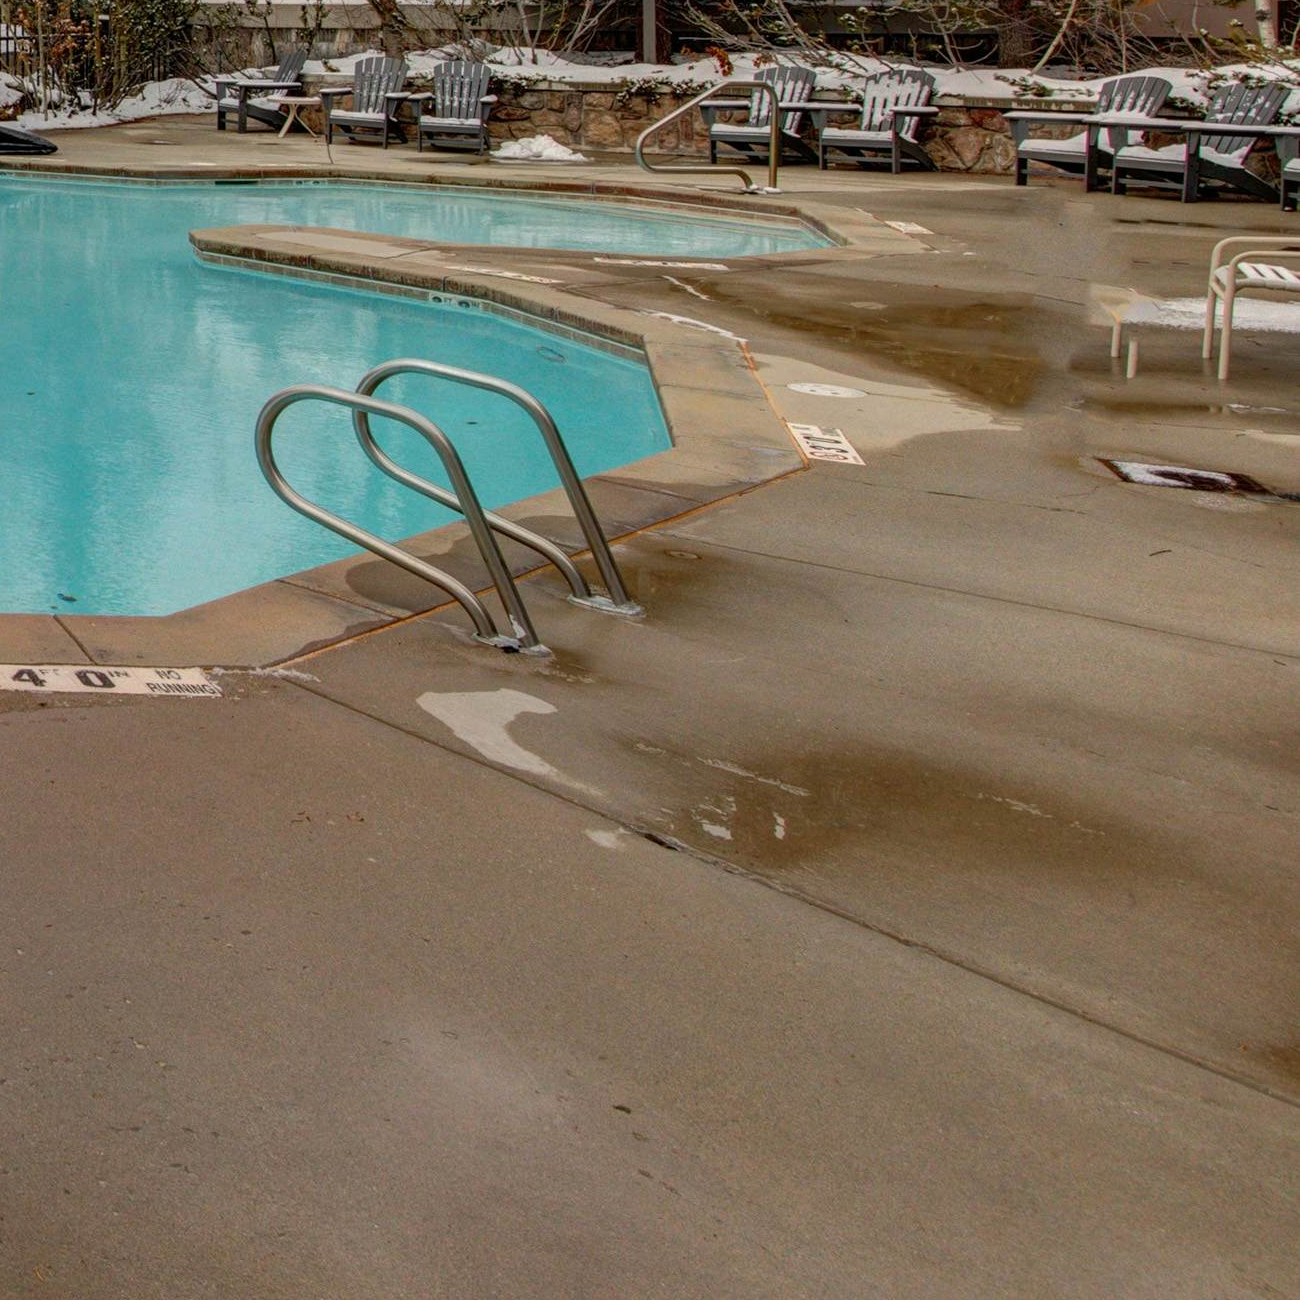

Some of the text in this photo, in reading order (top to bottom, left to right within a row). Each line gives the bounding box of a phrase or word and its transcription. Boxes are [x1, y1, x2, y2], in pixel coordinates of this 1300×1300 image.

[12, 668, 48, 688] 4
[74, 668, 116, 689] 0
[154, 669, 182, 680] NO
[145, 682, 218, 695] RUNNING
